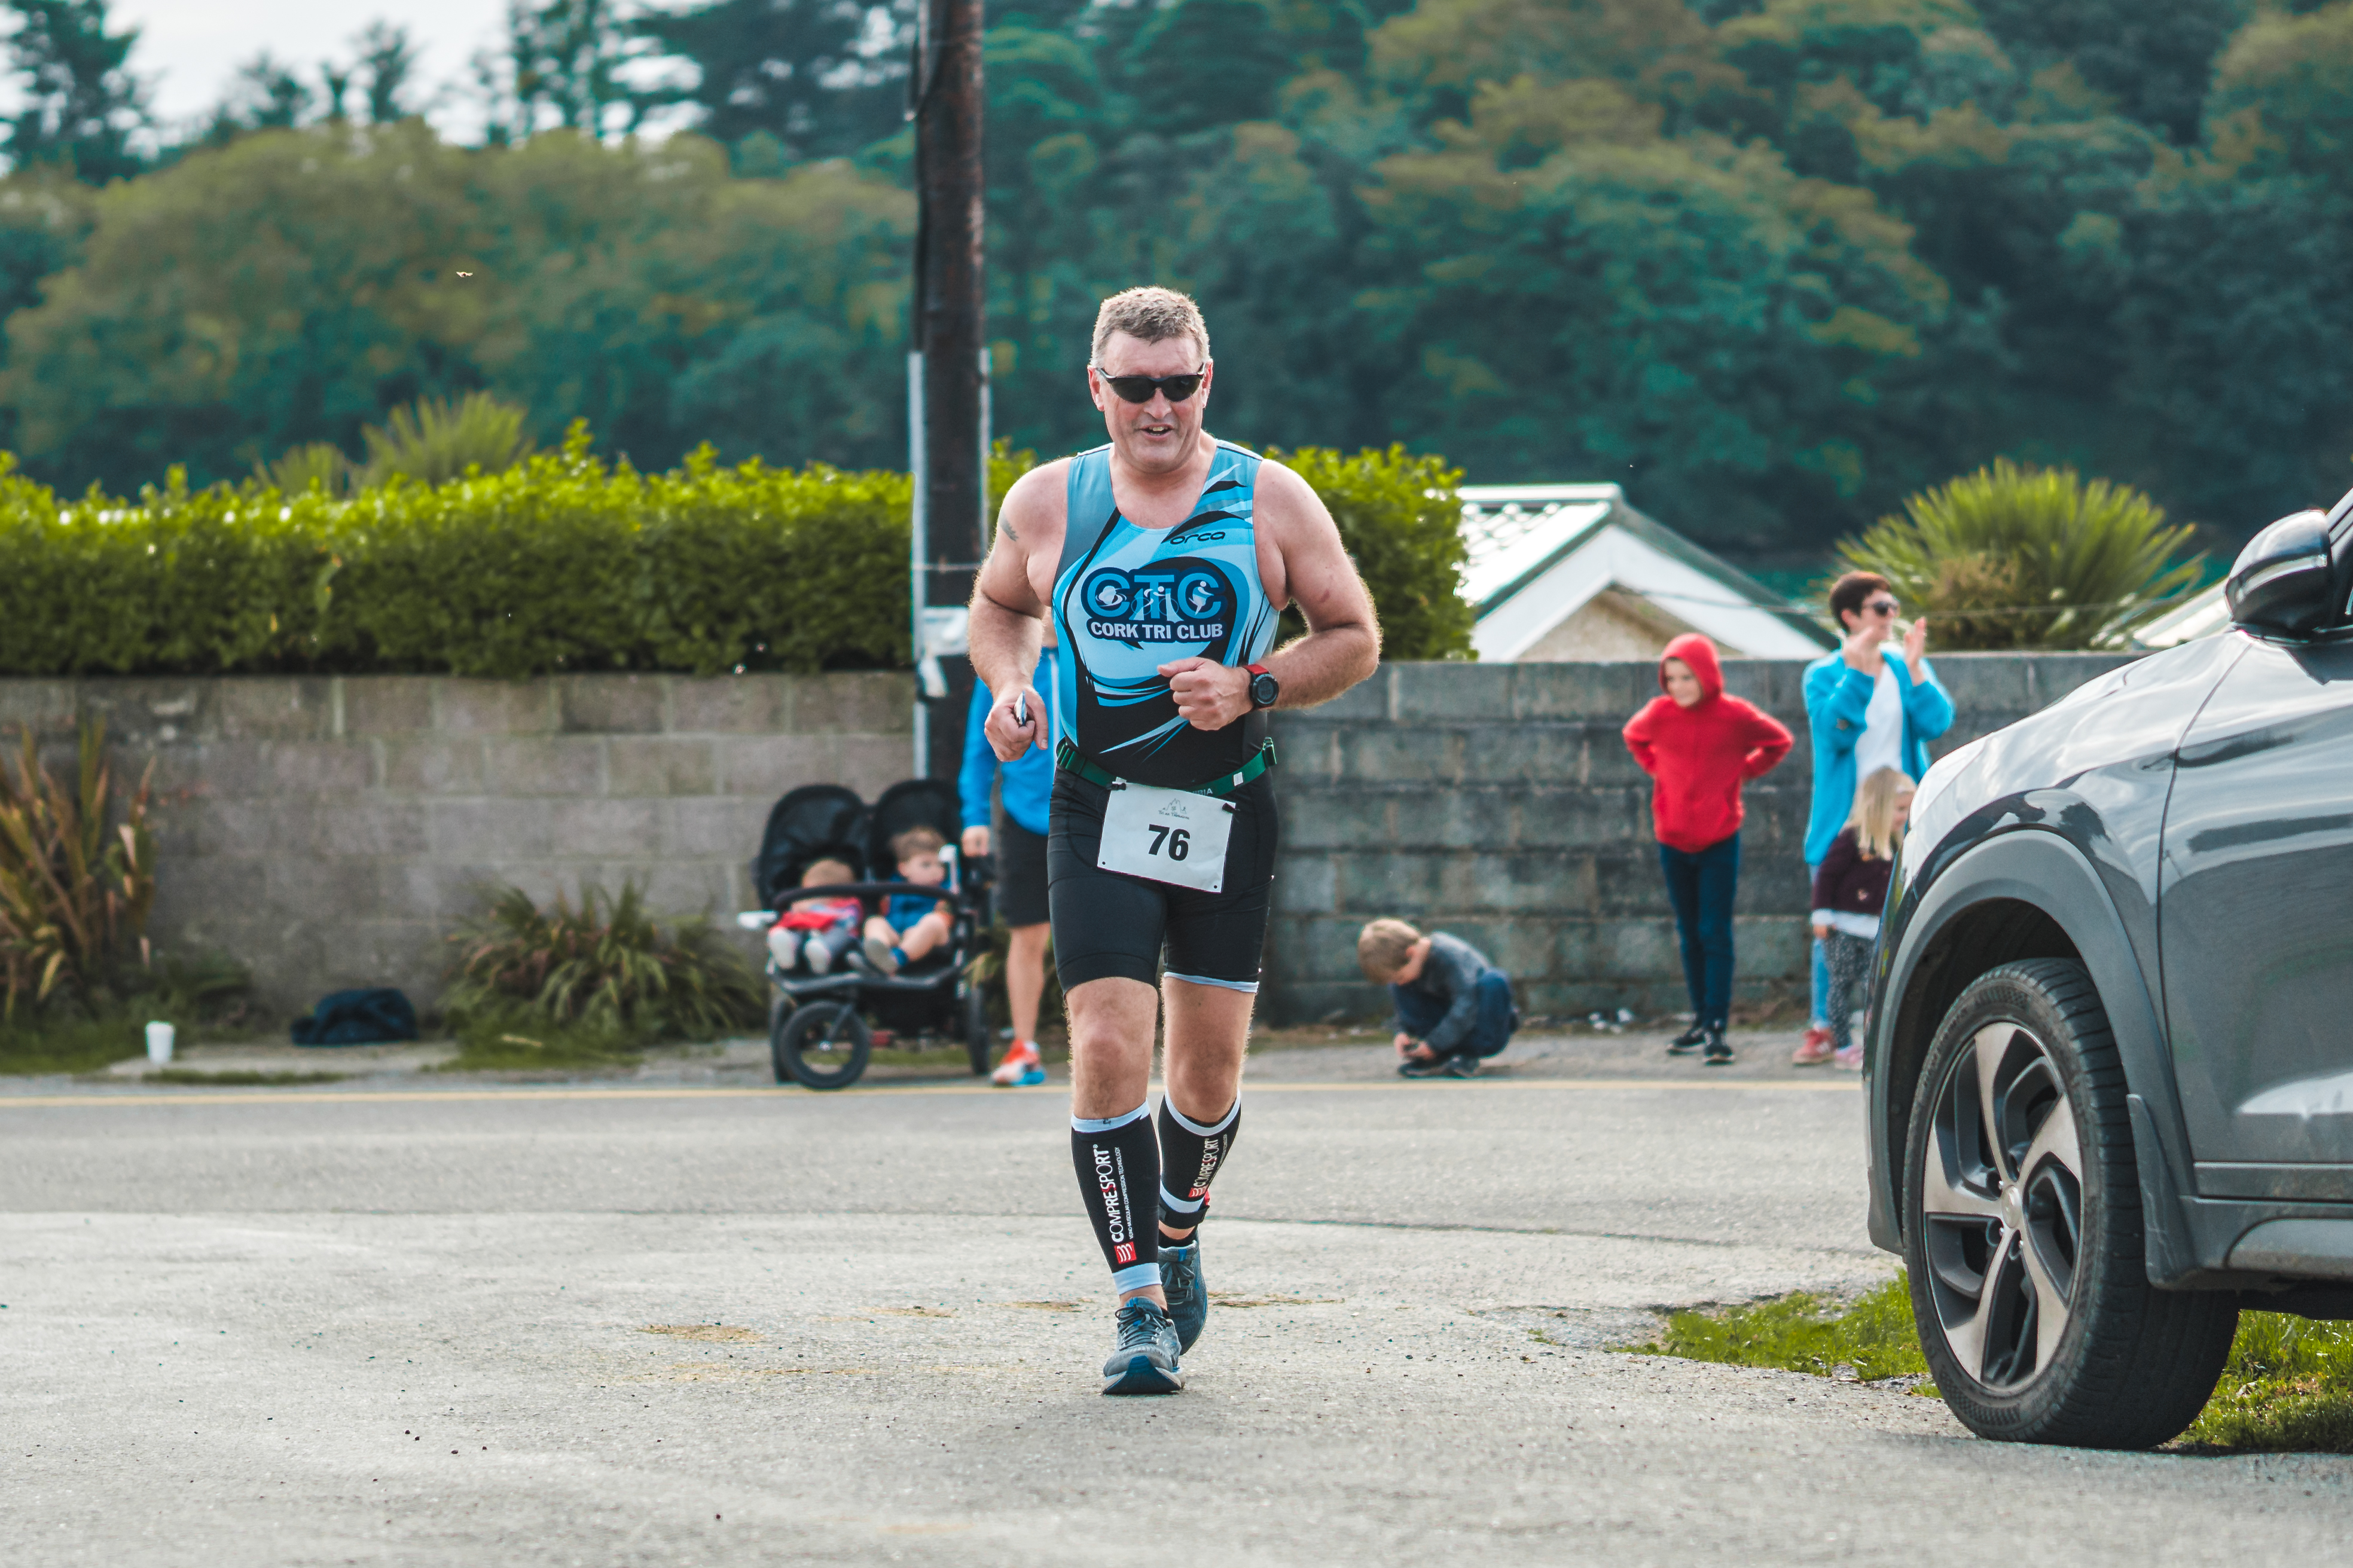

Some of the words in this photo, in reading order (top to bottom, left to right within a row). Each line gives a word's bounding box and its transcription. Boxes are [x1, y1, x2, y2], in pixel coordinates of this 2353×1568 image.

[1170, 531, 1226, 545] orca
[1087, 573, 1222, 619] CTC
[1091, 622, 1139, 638] CORK
[1142, 624, 1171, 639] TRI
[1177, 623, 1223, 639] CLUB
[1148, 824, 1191, 861] 76
